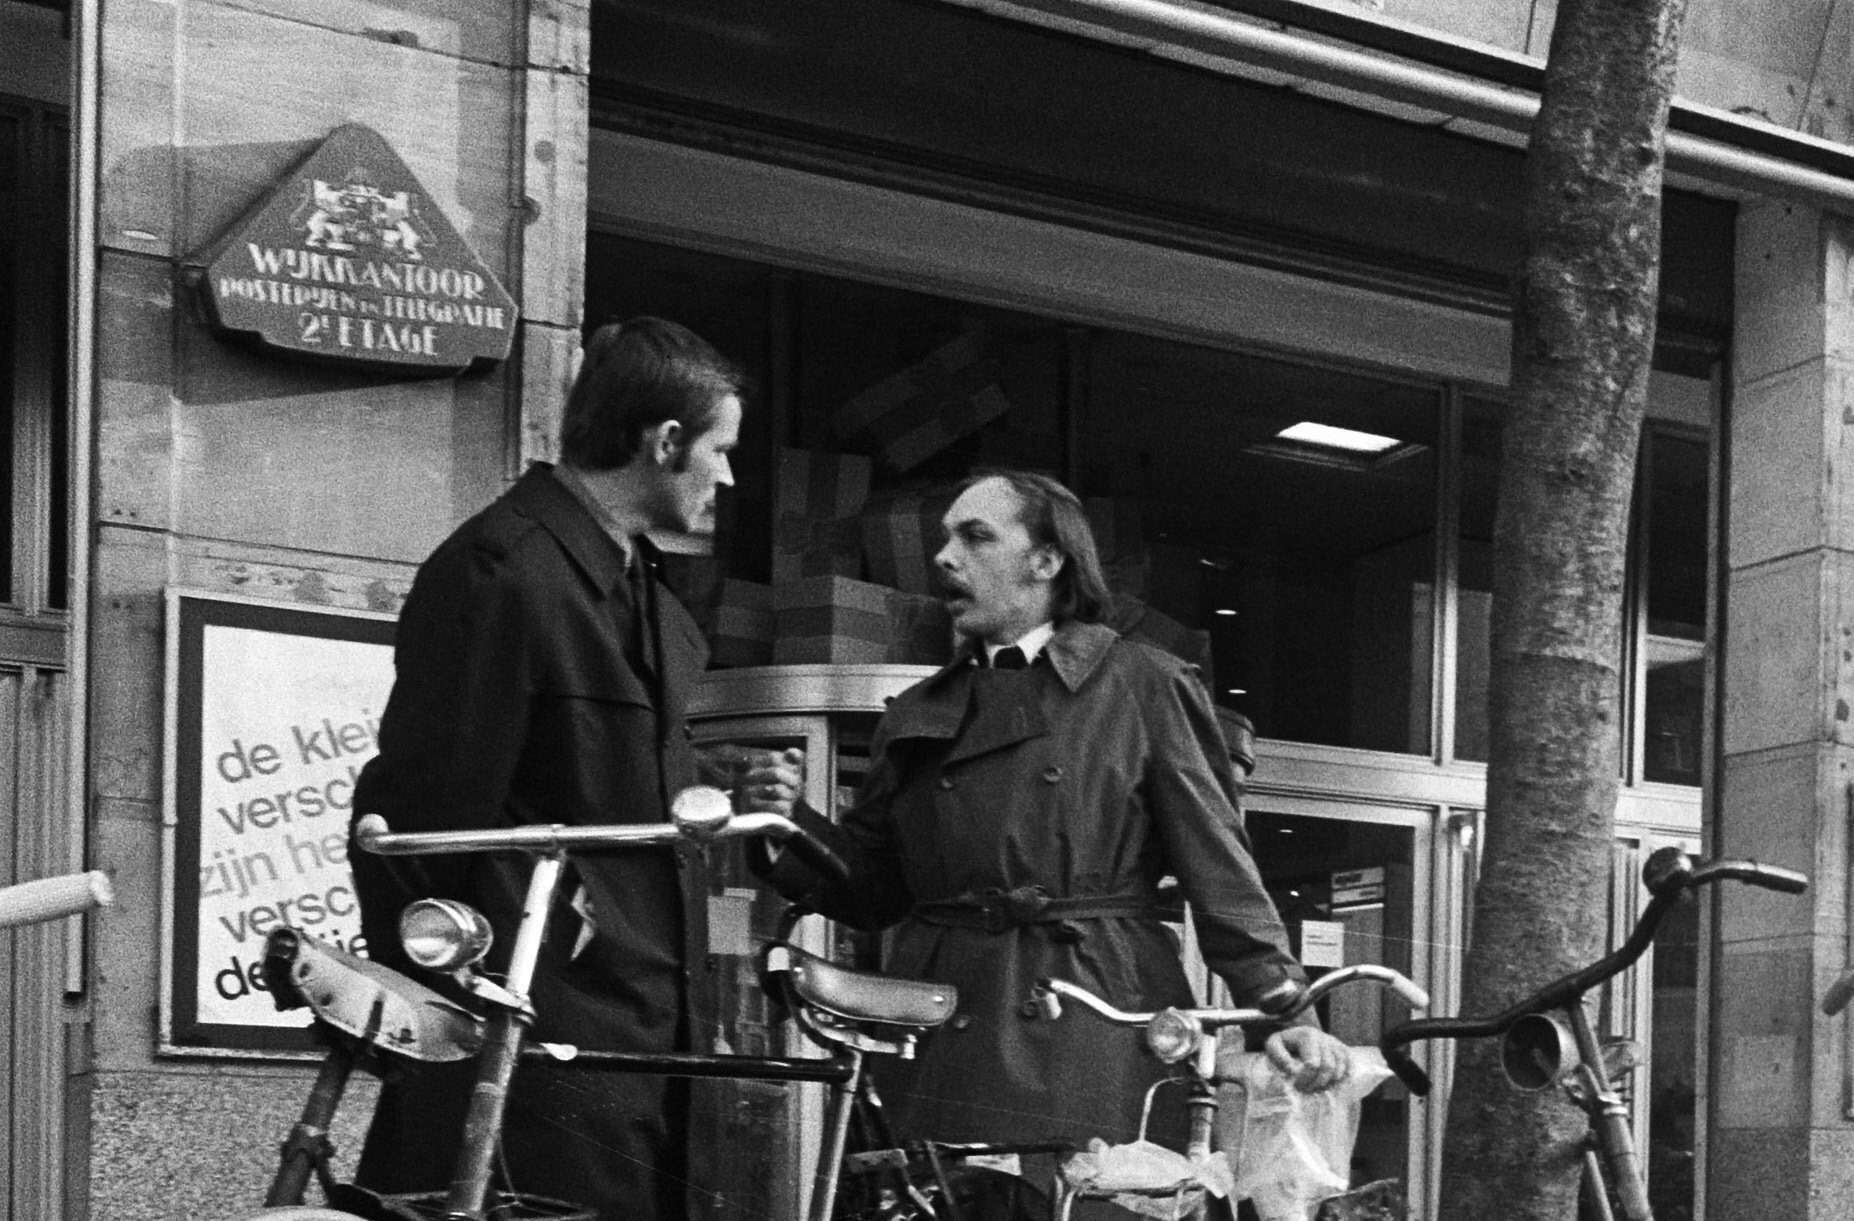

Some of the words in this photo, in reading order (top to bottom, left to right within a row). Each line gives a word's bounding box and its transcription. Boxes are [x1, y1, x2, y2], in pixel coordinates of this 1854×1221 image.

[338, 316, 438, 356] ETAGE
[217, 738, 281, 783] de
[291, 707, 381, 766] klei
[217, 766, 358, 835] versc
[200, 848, 278, 899] zijn
[215, 956, 270, 1001] de
